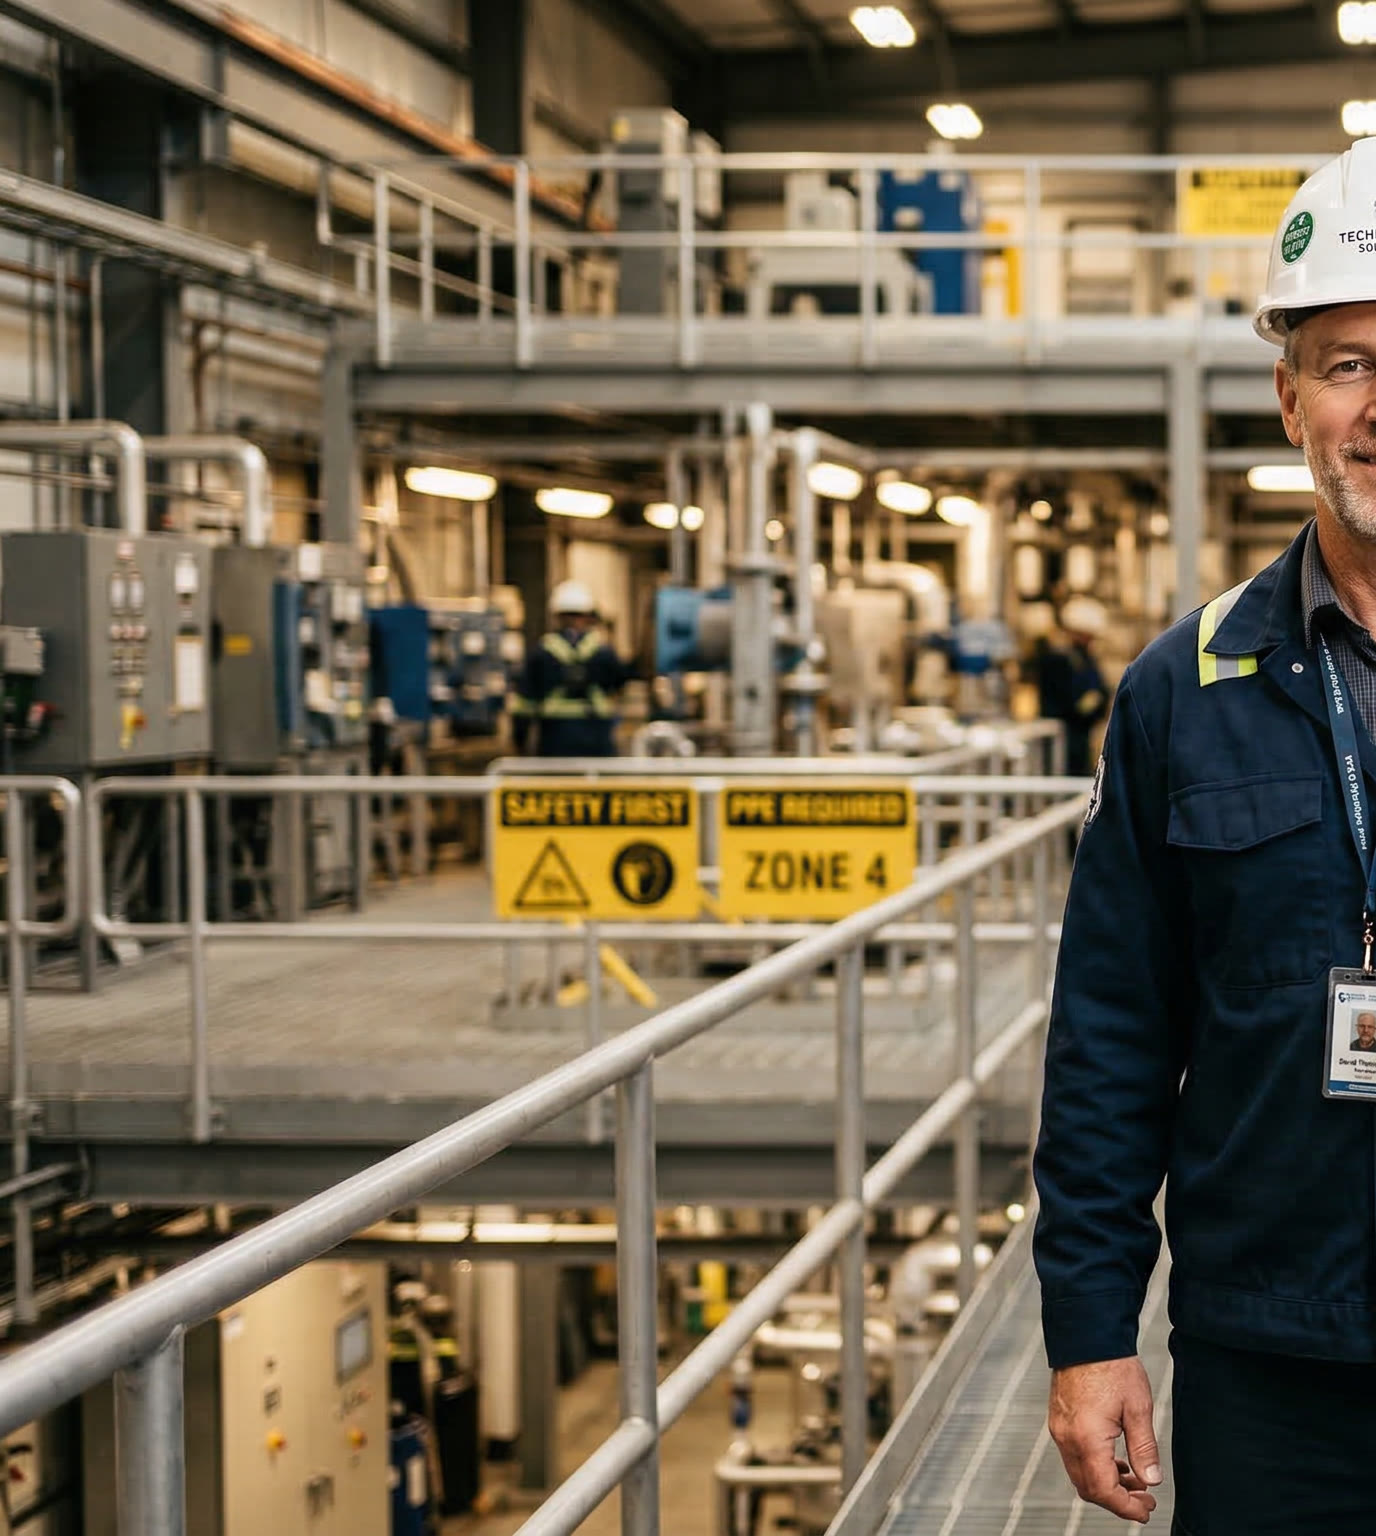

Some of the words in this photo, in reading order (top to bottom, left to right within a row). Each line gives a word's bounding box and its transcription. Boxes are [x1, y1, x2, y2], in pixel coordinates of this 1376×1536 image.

[506, 793, 603, 824] SAFETY
[608, 793, 685, 824] FIRST
[731, 793, 776, 824] PPE
[781, 793, 904, 824] REQUIRED
[745, 851, 850, 891] ZONE
[865, 852, 887, 890] 4
